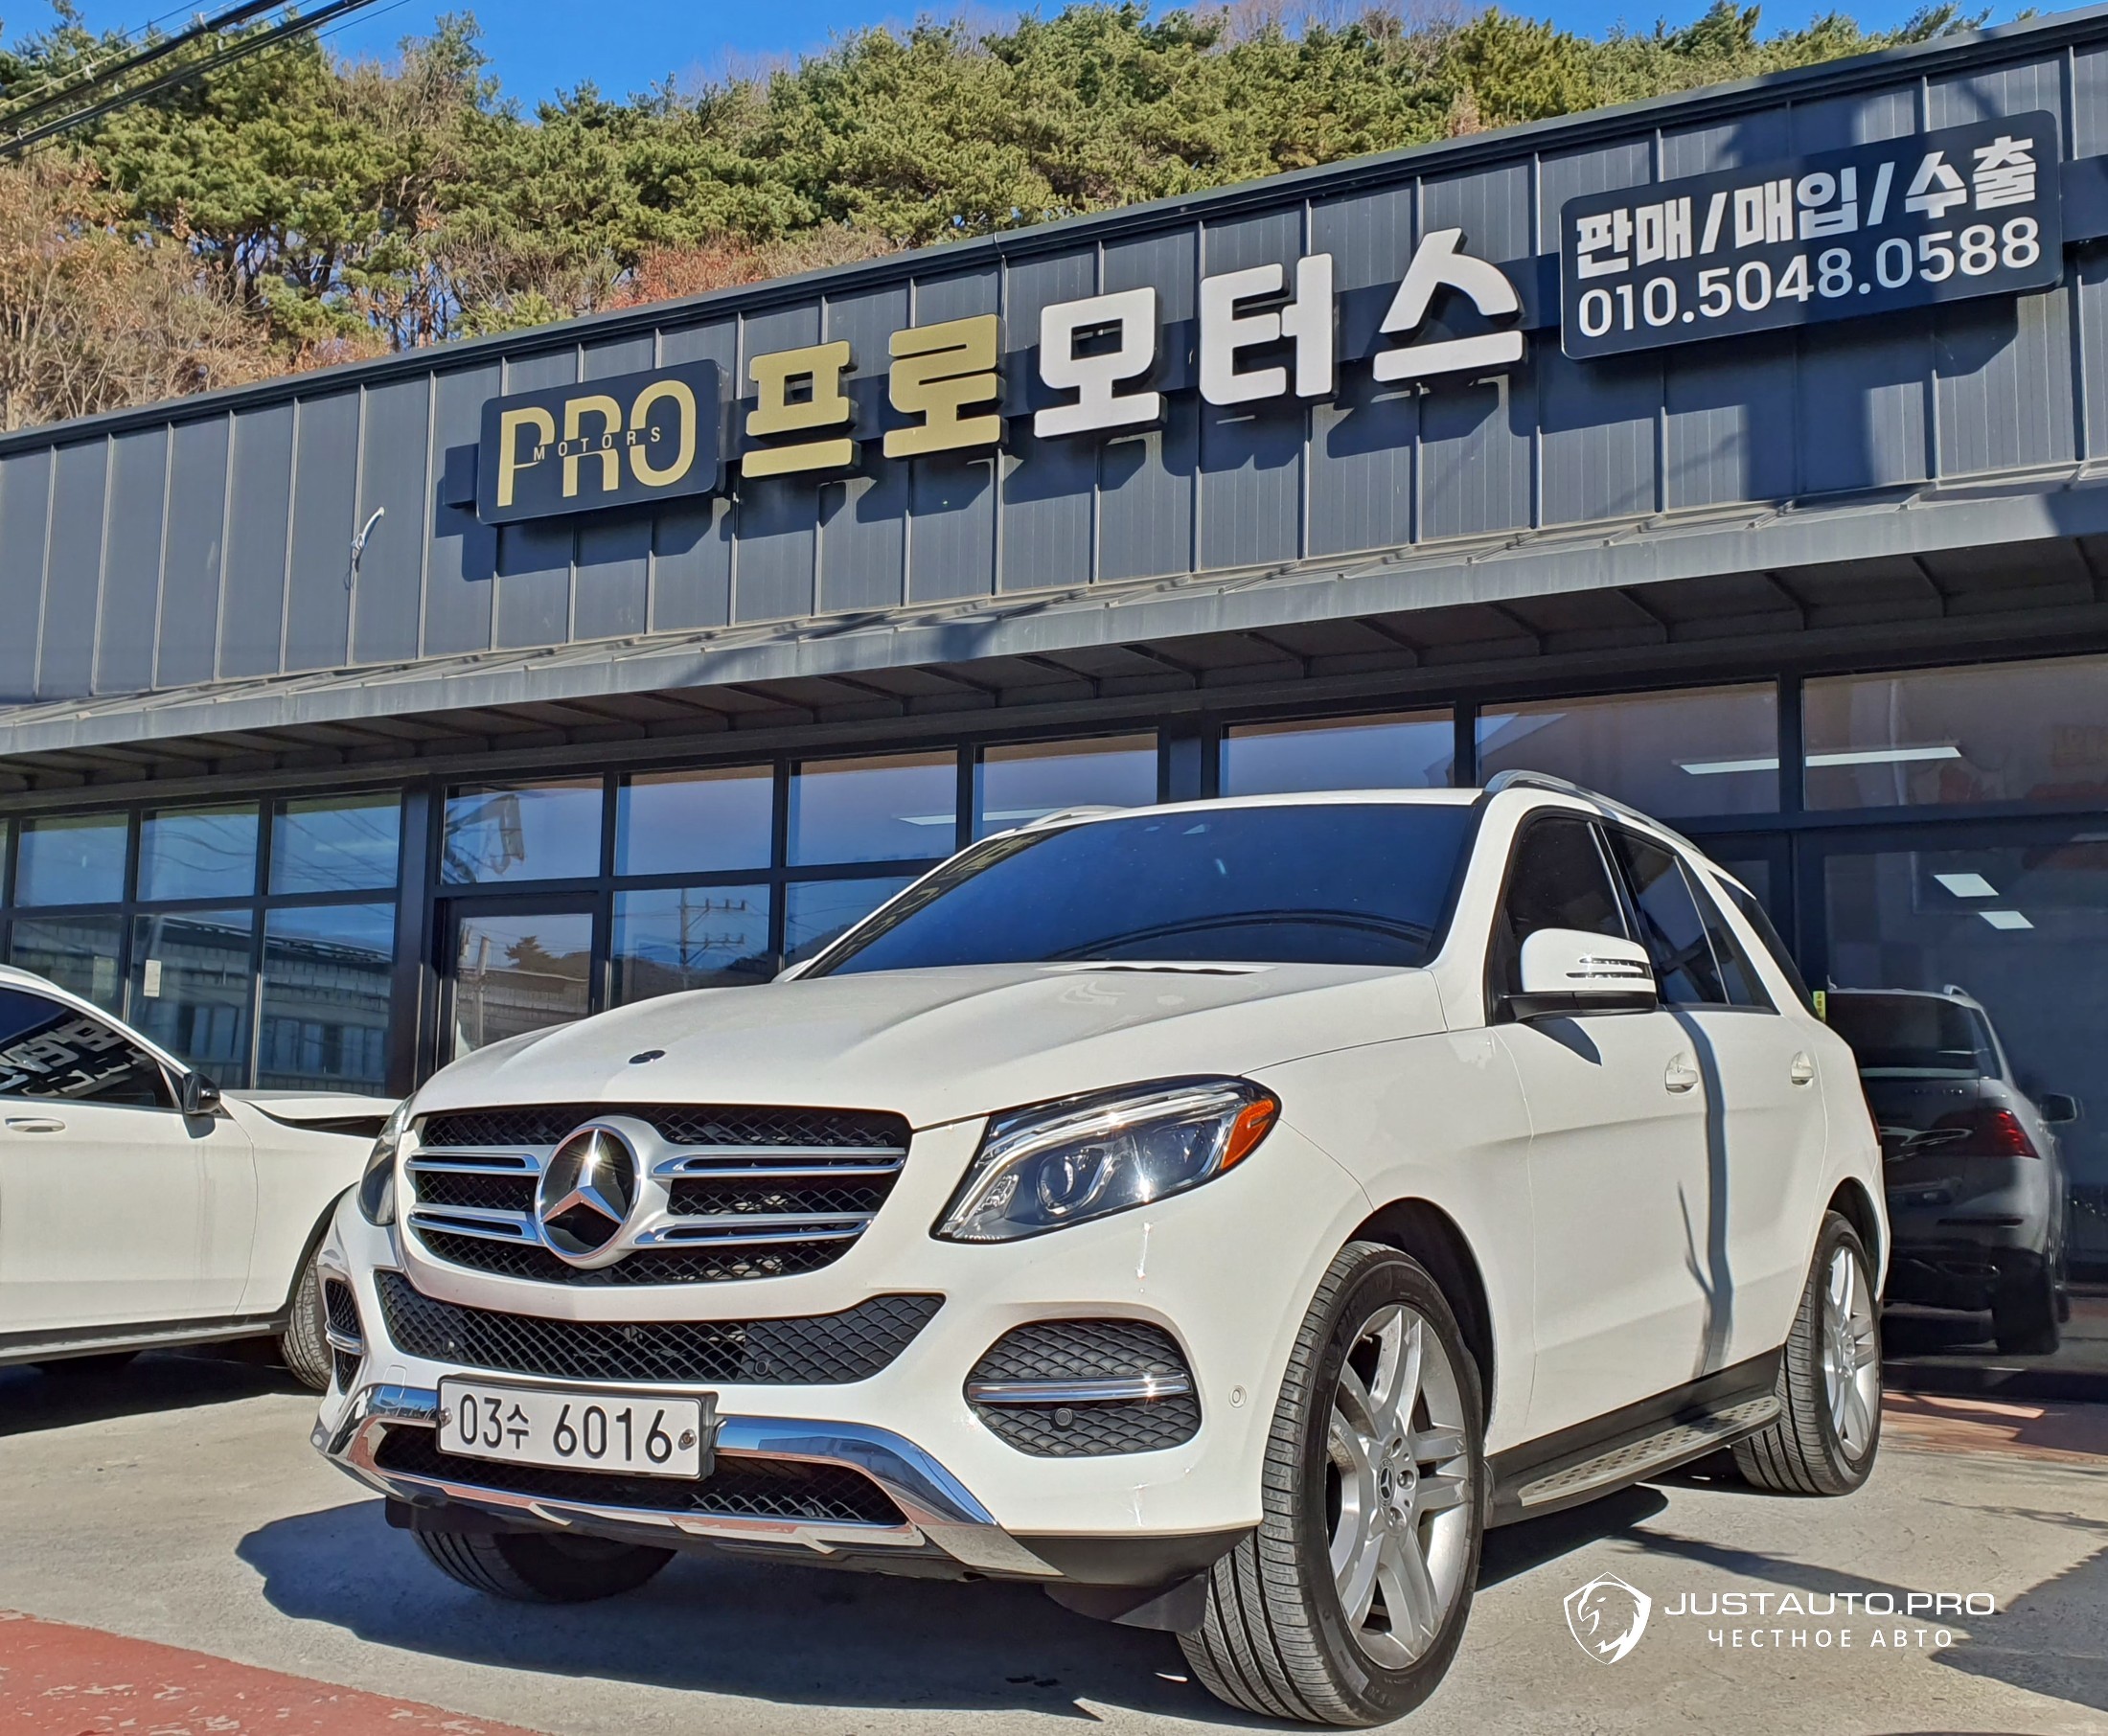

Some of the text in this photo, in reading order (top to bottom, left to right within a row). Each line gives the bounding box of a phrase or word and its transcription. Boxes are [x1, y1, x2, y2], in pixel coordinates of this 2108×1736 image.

[1576, 135, 2037, 279] 판매/매입/수출
[1578, 217, 2040, 338] 010.5048.0588
[496, 379, 697, 507] PRO
[533, 426, 661, 462] MOTORS
[459, 1393, 673, 1464] 03수 6016
